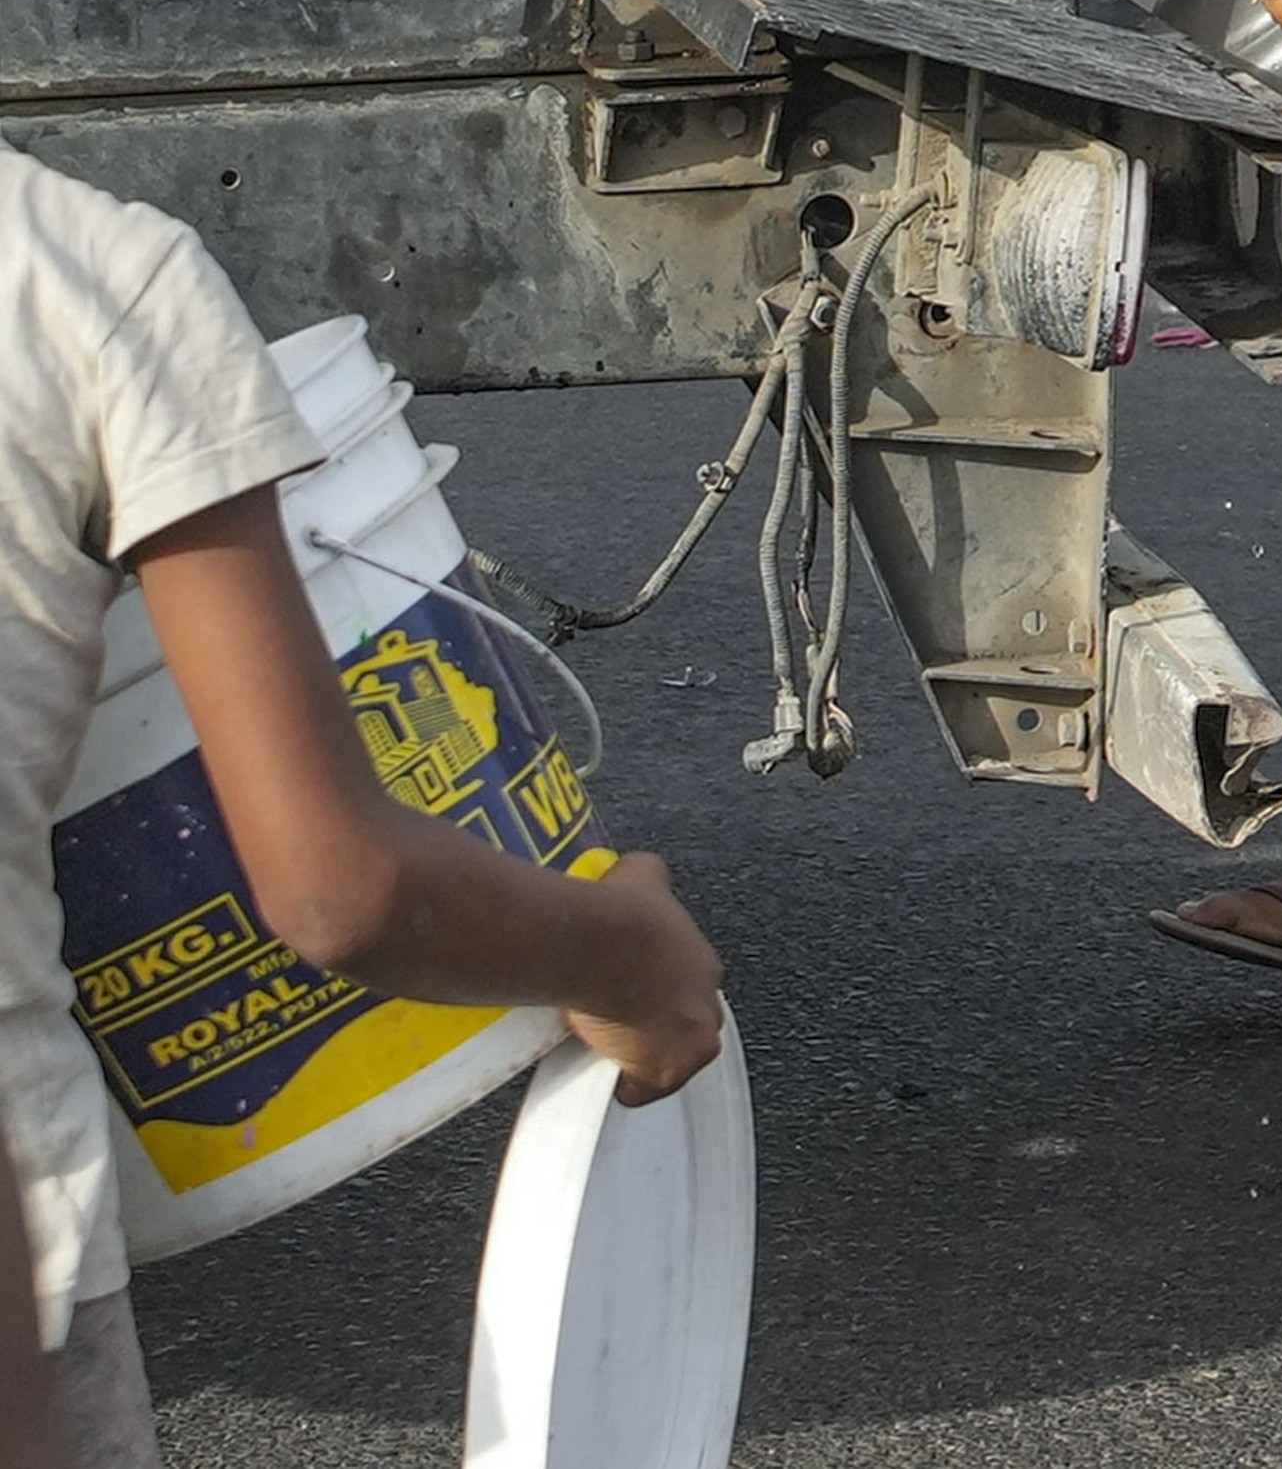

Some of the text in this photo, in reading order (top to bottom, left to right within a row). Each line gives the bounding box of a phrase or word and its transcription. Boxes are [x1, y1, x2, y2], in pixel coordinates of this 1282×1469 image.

[83, 924, 237, 1009] 20 KG.
[148, 976, 310, 1068] ROYAL
